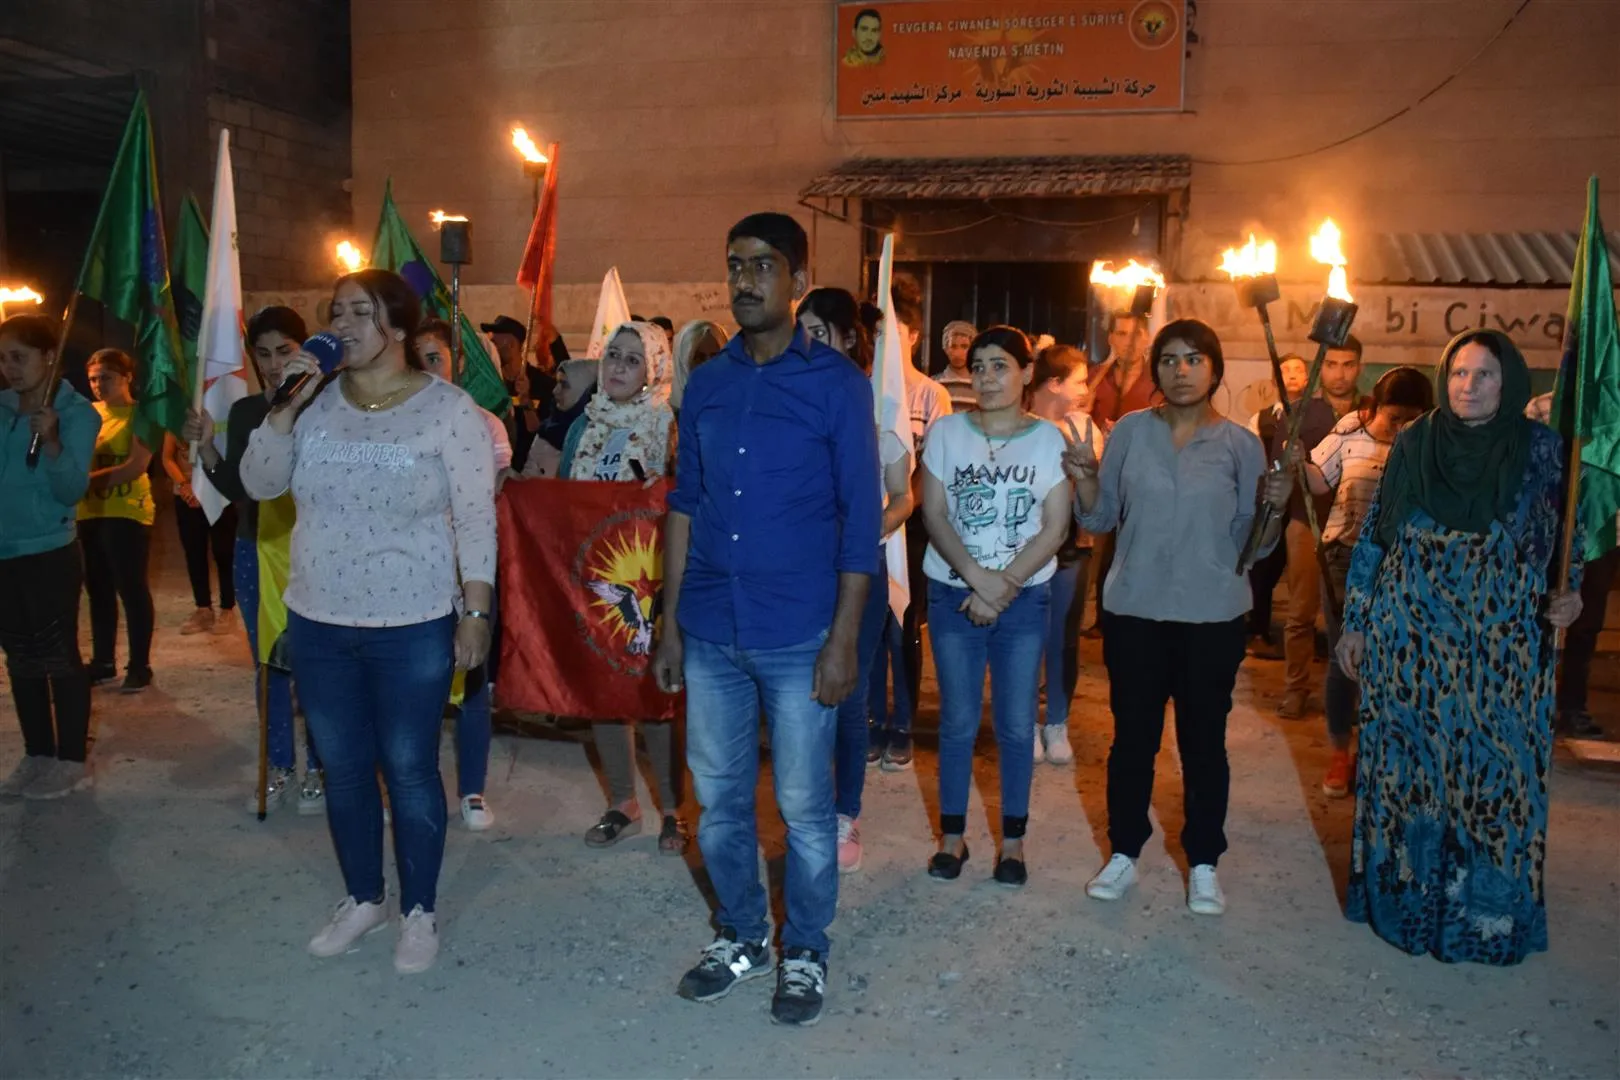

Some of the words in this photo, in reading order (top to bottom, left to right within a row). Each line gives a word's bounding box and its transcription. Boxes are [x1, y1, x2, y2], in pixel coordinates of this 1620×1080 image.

[892, 21, 943, 34] TEVGERA
[948, 45, 1007, 59] NAVENDA
[862, 87, 886, 106] متين
[890, 82, 930, 103] الشهيد
[934, 84, 962, 103] مركز
[975, 82, 1021, 102] السورية
[1026, 78, 1068, 101] الثورية
[1073, 77, 1120, 99] الشبيبة
[1124, 78, 1156, 97] حركة
[1385, 296, 1419, 334] bi
[1444, 301, 1566, 343] Ciwa
